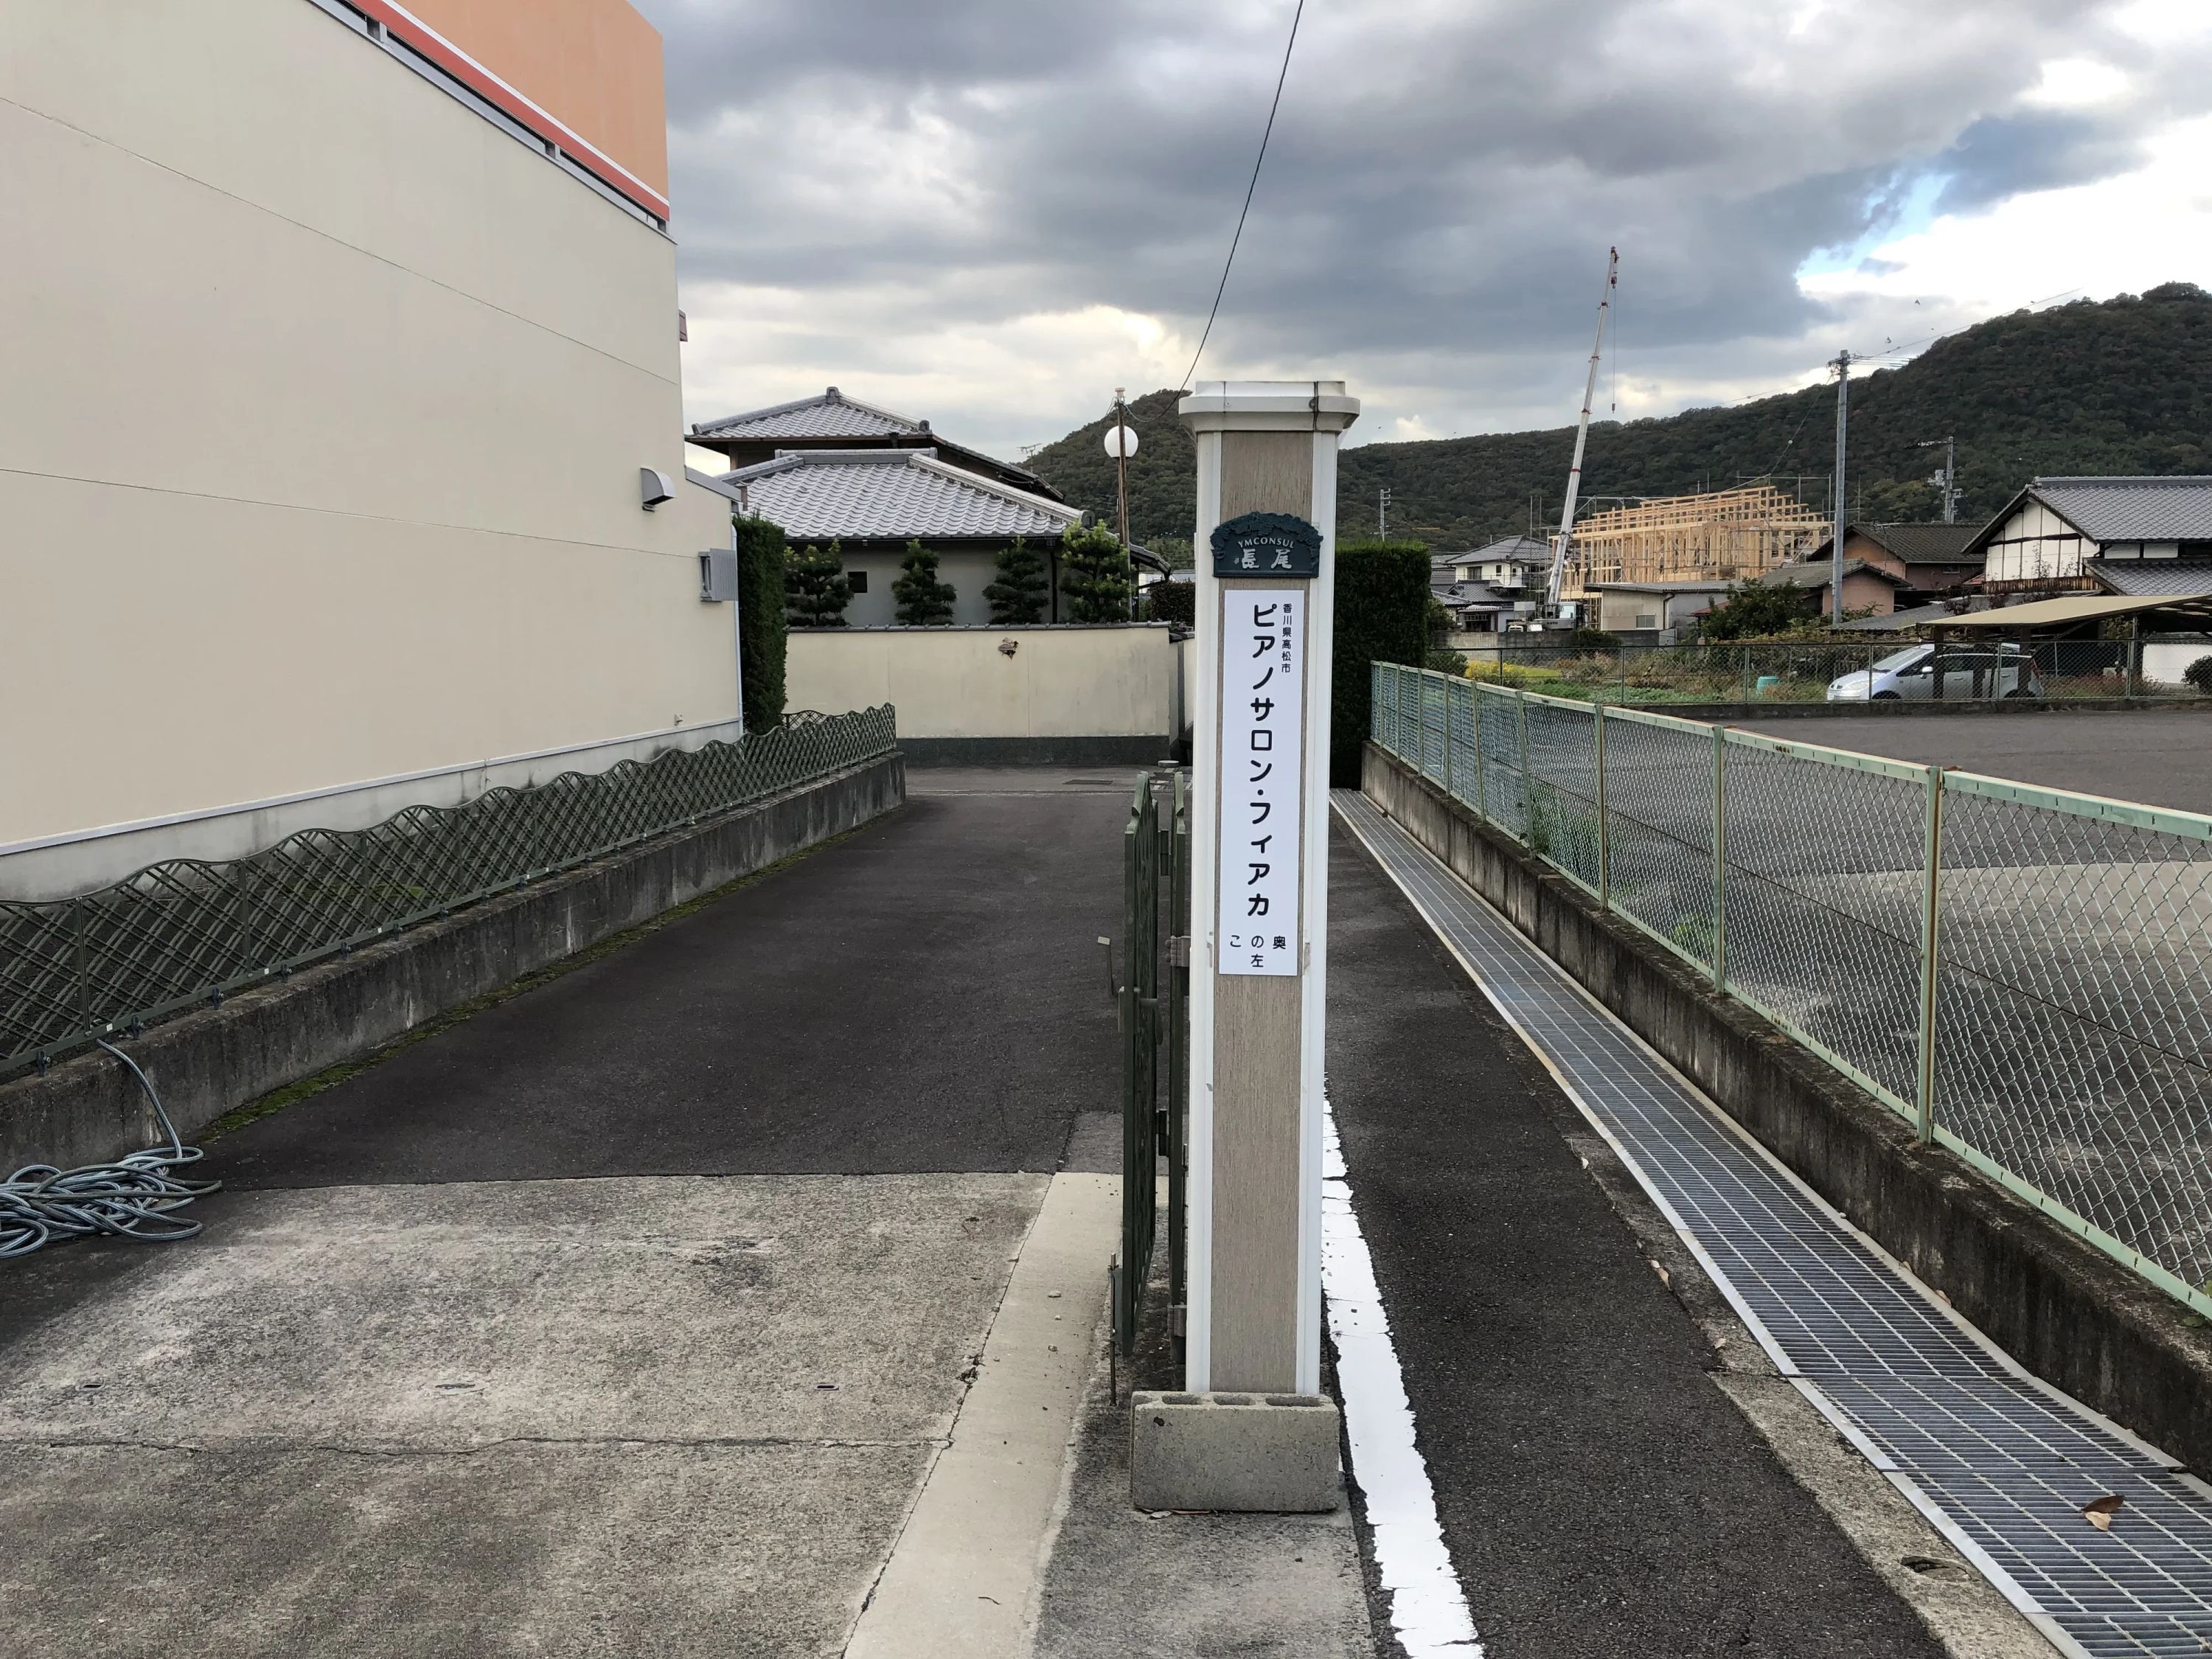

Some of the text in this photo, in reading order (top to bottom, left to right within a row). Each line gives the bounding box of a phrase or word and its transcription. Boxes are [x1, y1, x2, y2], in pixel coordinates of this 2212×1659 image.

[1238, 537, 1294, 549] YMCONSUL
[1242, 548, 1292, 569] 長尾
[1281, 603, 1293, 673] 香川県高松市
[1248, 603, 1278, 917] ピアノサロン・フィアカ
